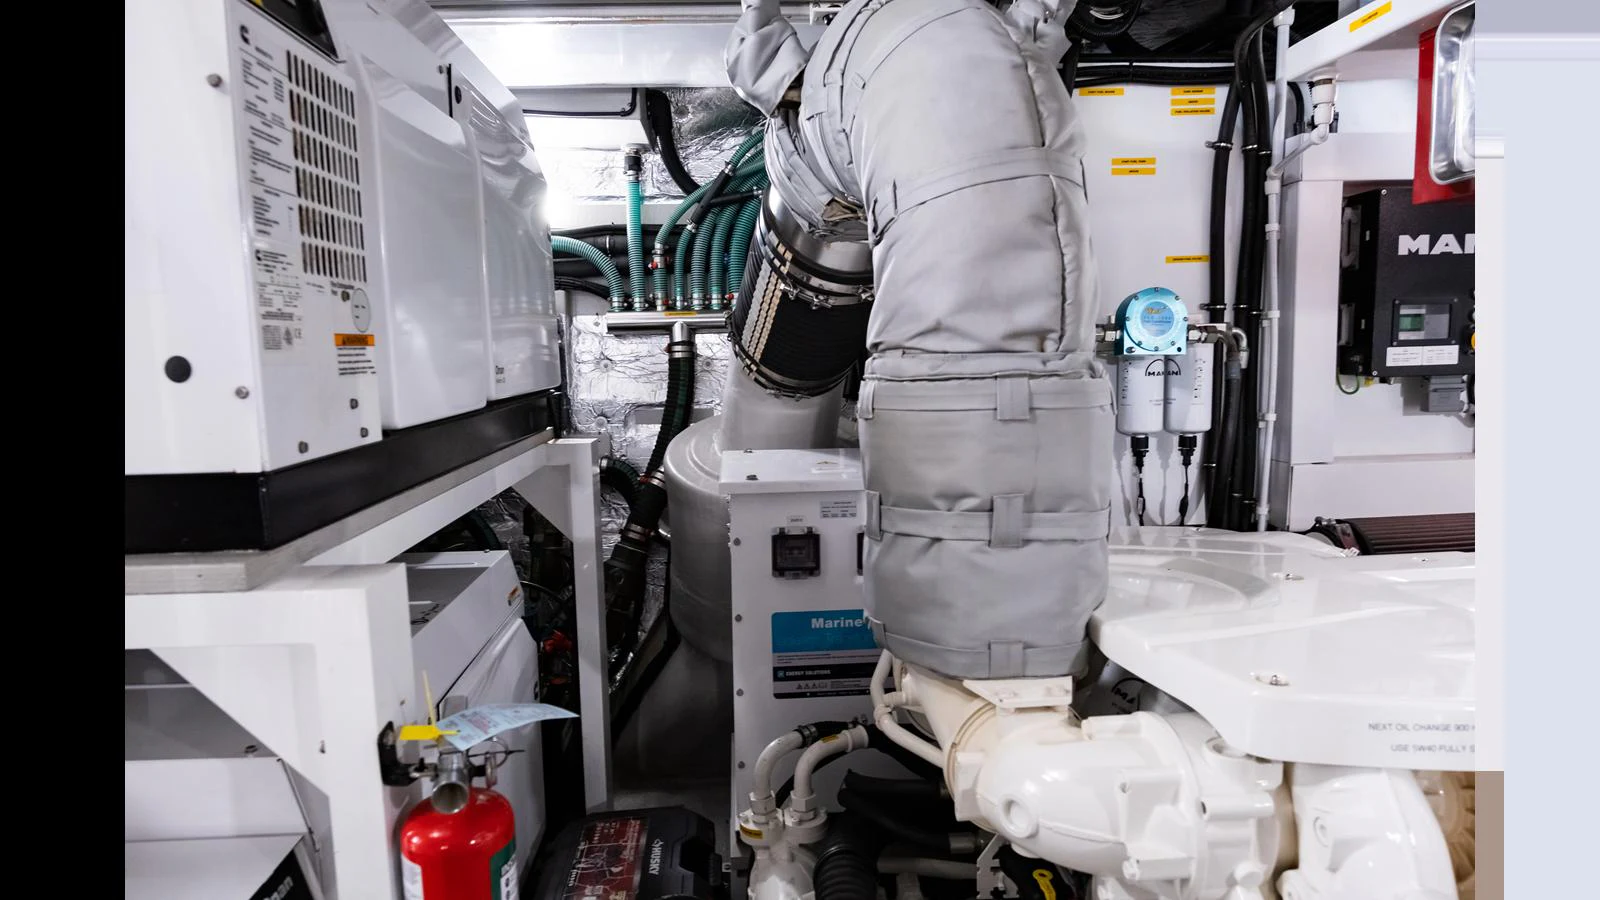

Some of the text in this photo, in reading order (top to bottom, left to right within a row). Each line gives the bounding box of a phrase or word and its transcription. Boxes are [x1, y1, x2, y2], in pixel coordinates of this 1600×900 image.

[811, 616, 862, 629] Marine
[1368, 722, 1393, 731] NEXT
[1413, 722, 1452, 732] CHANGE
[648, 846, 663, 875] HUSKY
[263, 876, 294, 900] nan
